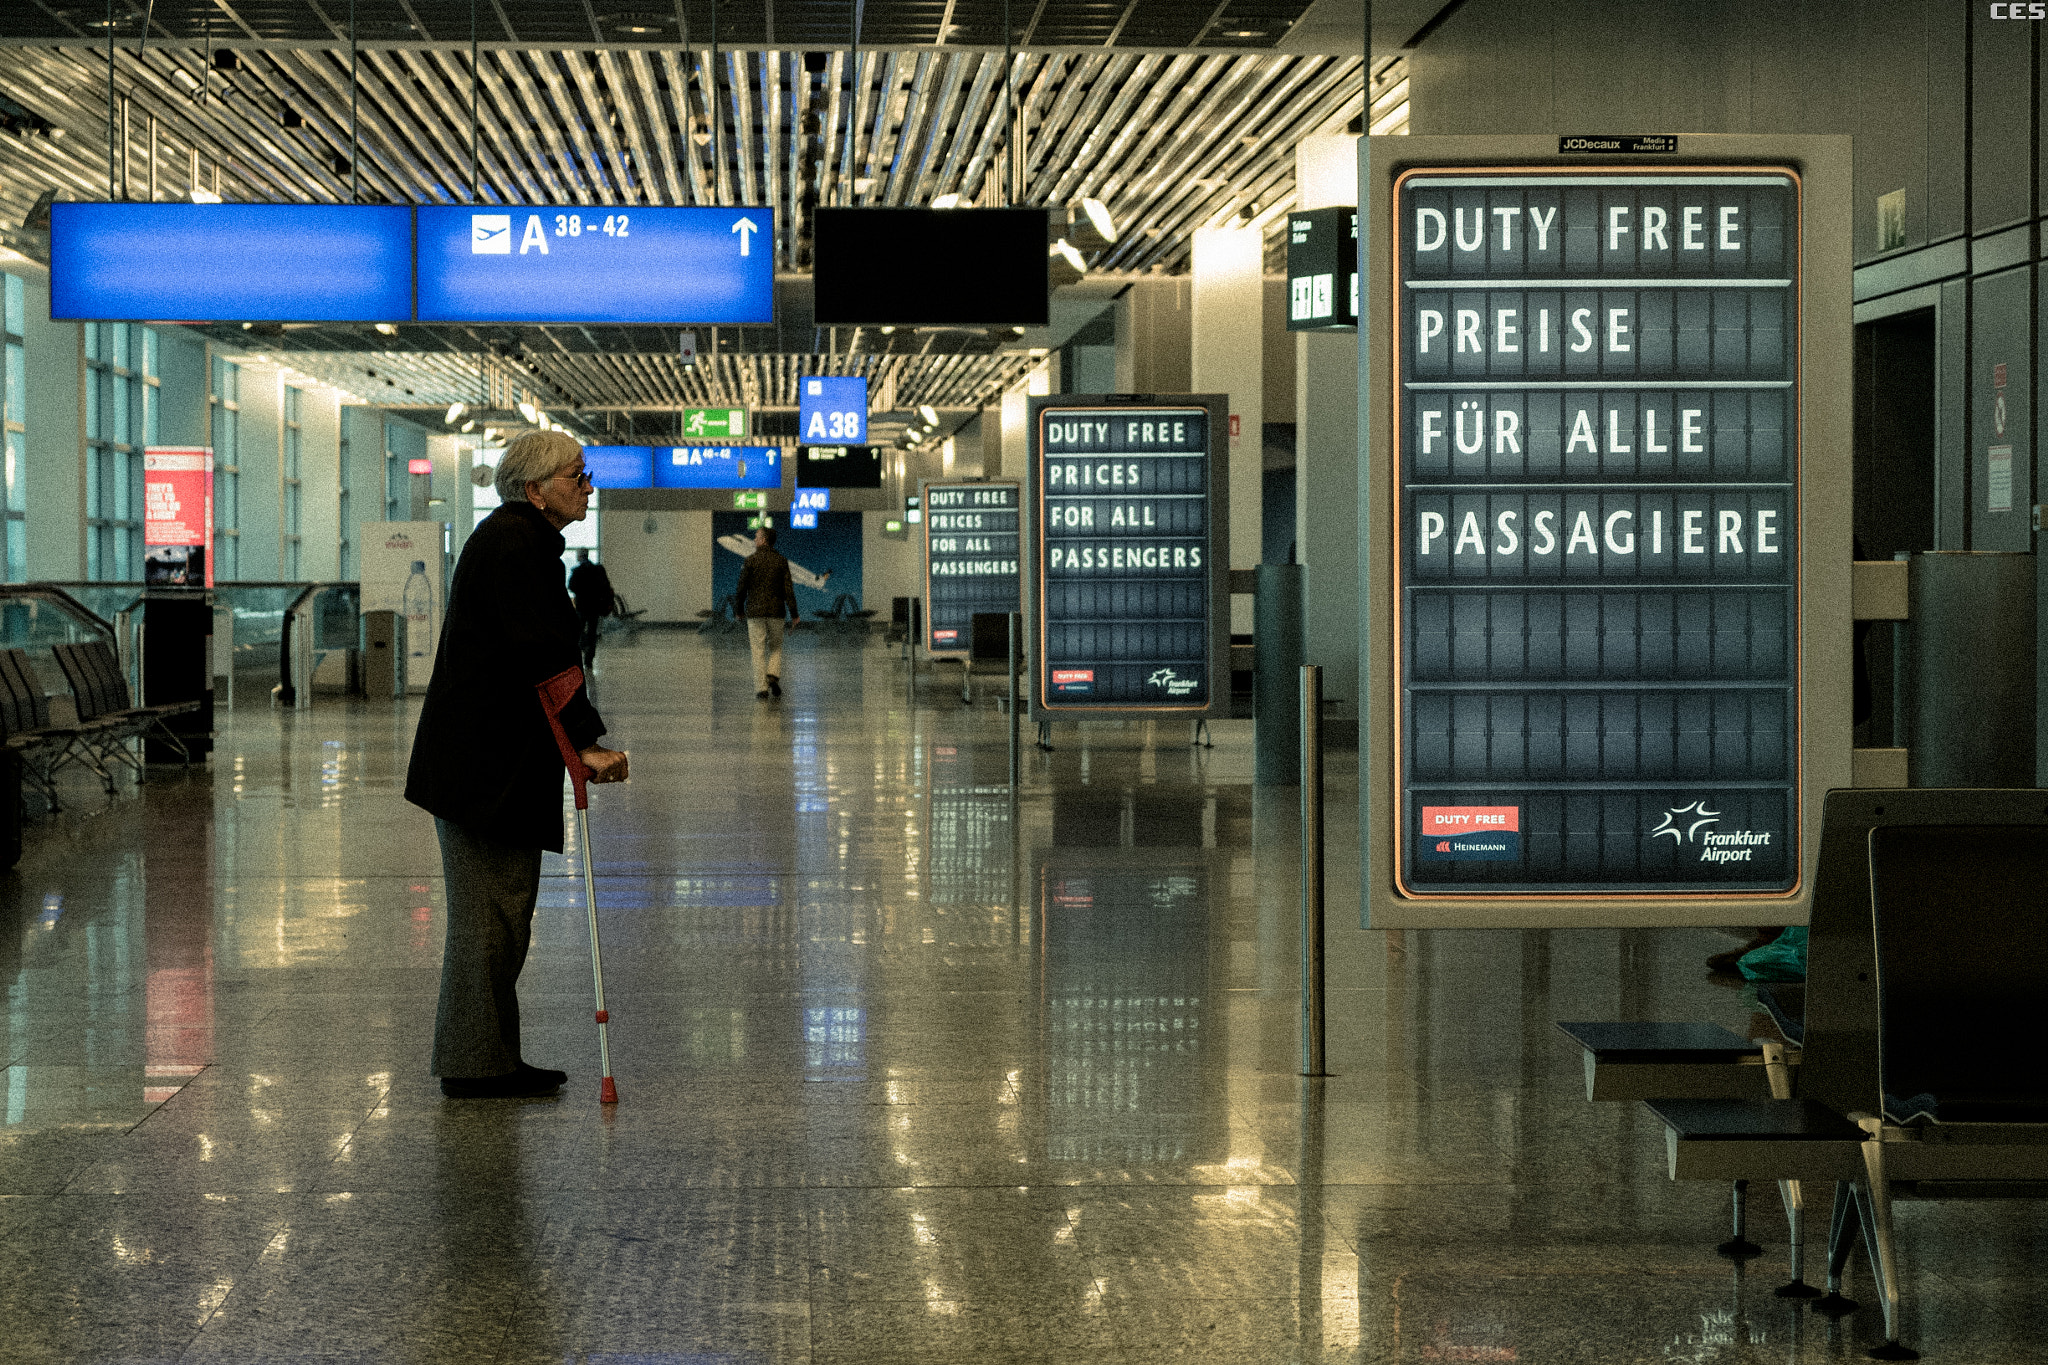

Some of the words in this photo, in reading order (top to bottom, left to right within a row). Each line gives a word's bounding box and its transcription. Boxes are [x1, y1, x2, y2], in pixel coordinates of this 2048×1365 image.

[1563, 139, 1620, 149] JCDecaux
[519, 215, 549, 255] A
[1416, 206, 1556, 252] DUTY
[1609, 206, 1741, 251] FREE
[1419, 308, 1631, 354] PREISE
[1049, 422, 1108, 443] DUTY
[1128, 422, 1185, 443] FREE
[1422, 400, 1521, 454] FÜR
[1566, 409, 1704, 453] ALLE
[690, 449, 702, 465] A
[1050, 464, 1139, 485] PRICES
[931, 492, 965, 505] DUTY
[974, 491, 1007, 504] FREE
[931, 515, 982, 528] PRICES
[1051, 506, 1094, 526] FOR
[1111, 505, 1155, 526] ALL
[1420, 510, 1779, 556] PASSAGIERE
[932, 538, 957, 551] FOR
[966, 538, 991, 551] ALL
[1051, 547, 1201, 568] PASSENGERS
[932, 560, 1018, 575] PASSENGERS
[1169, 680, 1198, 688] Frankfurt
[1436, 815, 1470, 825] DUTY
[1476, 815, 1505, 825] FREE
[1704, 831, 1771, 846] Frankfurt
[1701, 847, 1752, 865] Airport
